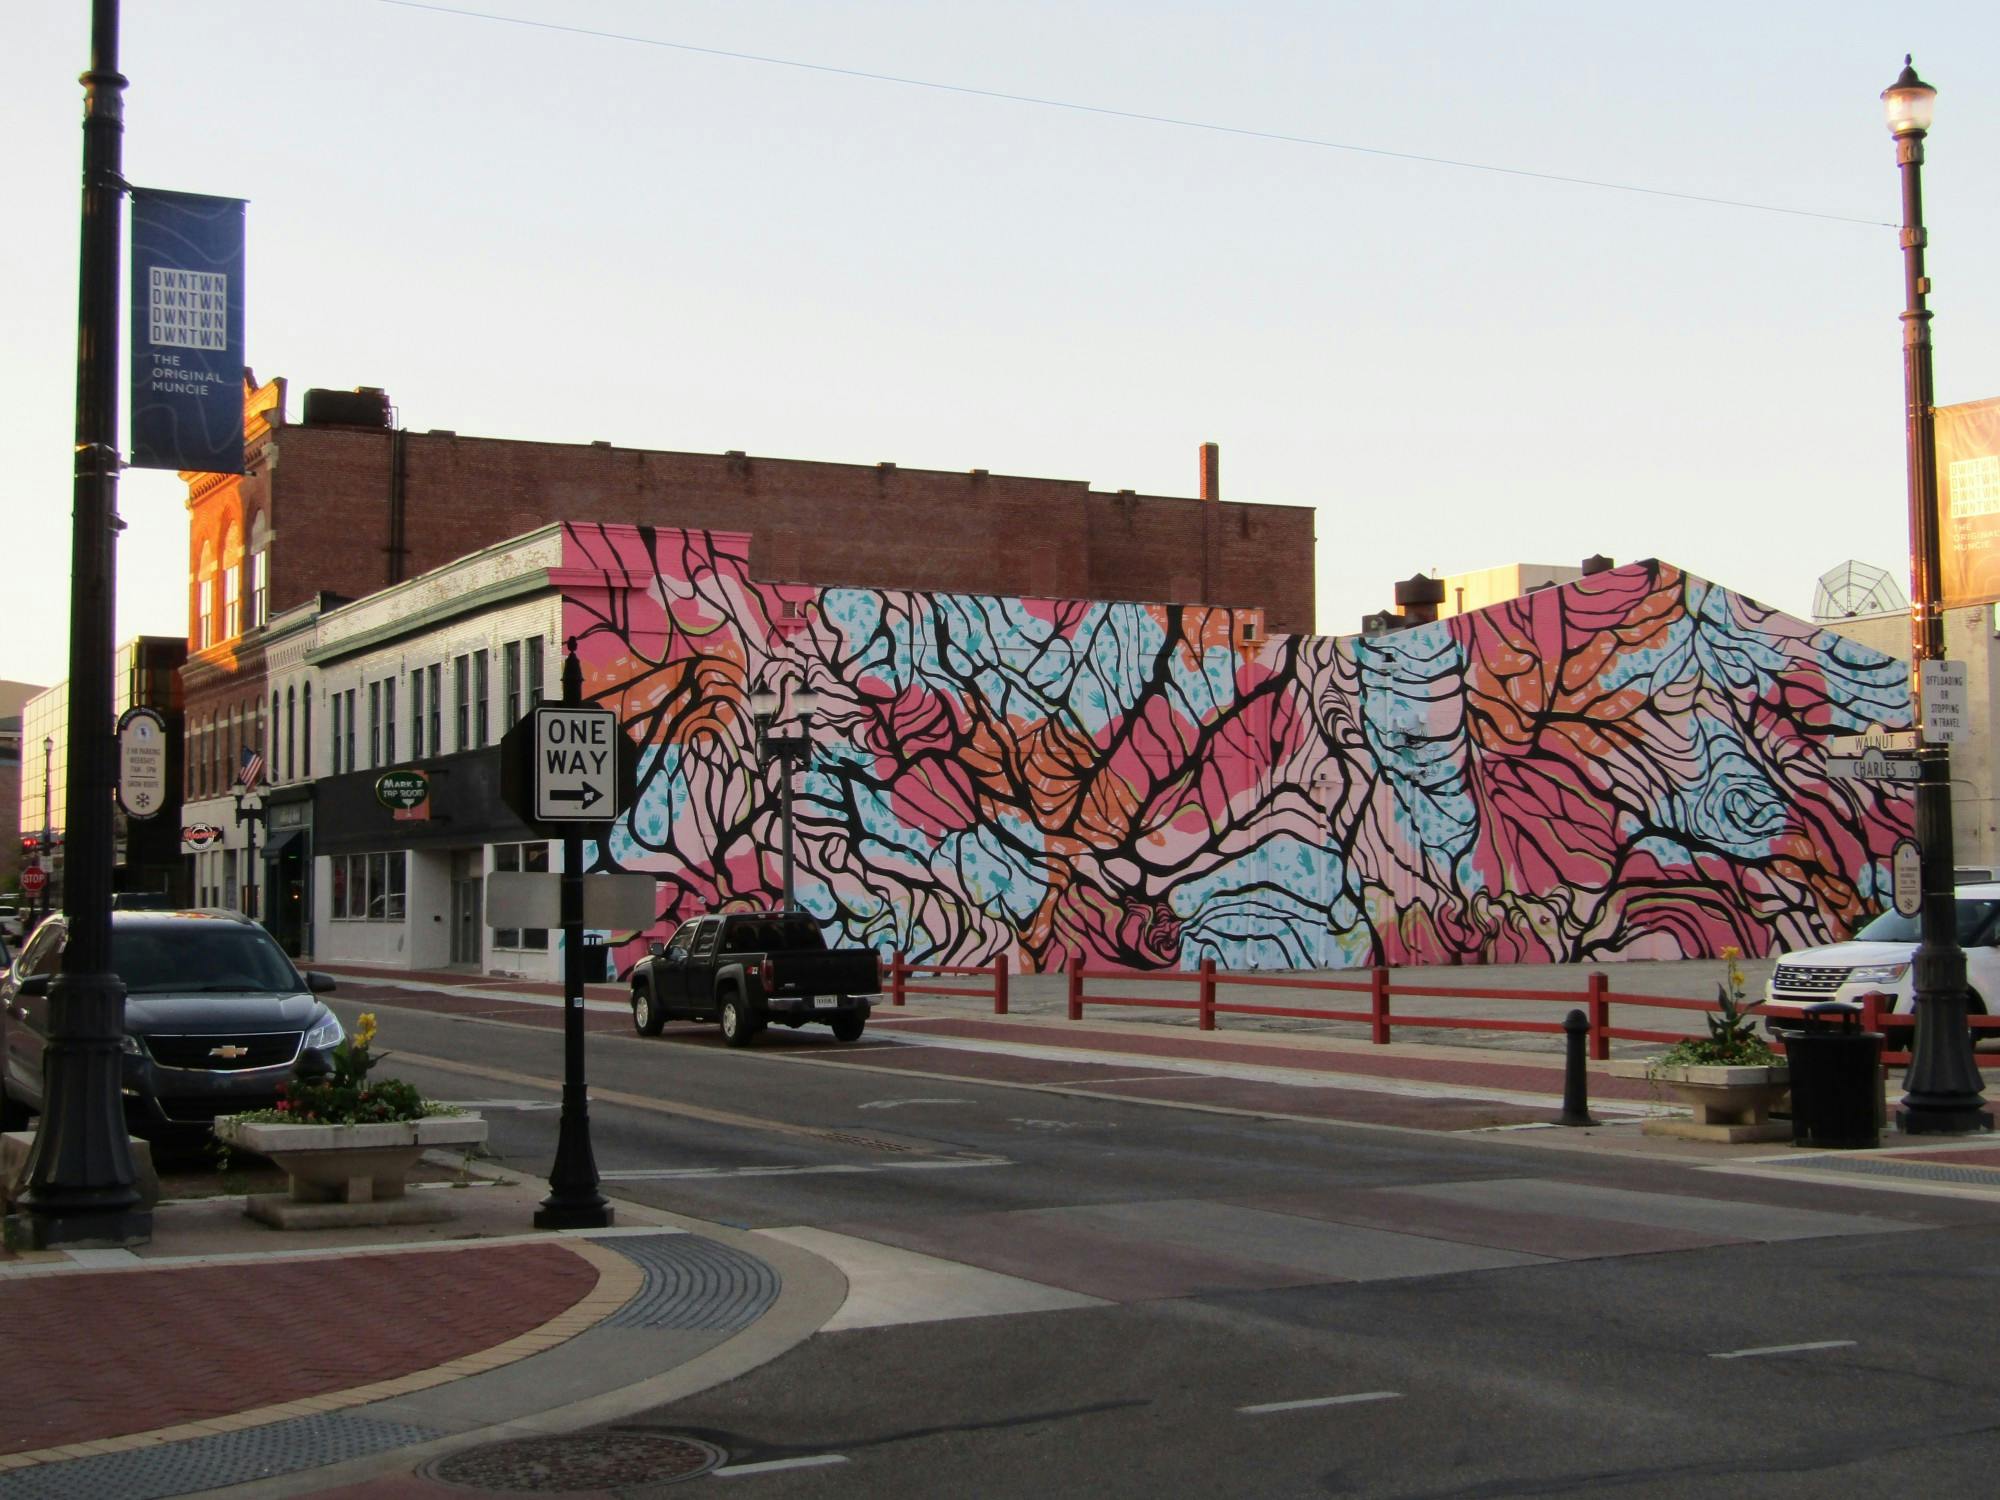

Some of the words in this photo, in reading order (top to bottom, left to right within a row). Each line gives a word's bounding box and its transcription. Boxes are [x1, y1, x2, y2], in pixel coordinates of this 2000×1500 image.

[152, 270, 224, 292] DWNTWN
[152, 288, 224, 311] DWNTWN
[152, 306, 224, 329] DWNTWN
[152, 325, 224, 347] DWNTWN
[152, 354, 181, 367] THE
[152, 367, 224, 384] ORIGINAL
[152, 381, 209, 396] MUNCIE
[1925, 675, 1963, 686] OFFLOADING
[1931, 703, 1960, 714] STOPPING
[1930, 718, 1938, 727] IN
[1938, 717, 1961, 728] TRAVEL
[548, 718, 607, 744] ONE
[1938, 731, 1954, 742] LANE
[1855, 734, 1895, 751] WALNUT
[1907, 735, 1920, 748] ST
[546, 749, 608, 775] WAY
[1853, 761, 1897, 777] CHARLES
[1909, 765, 1919, 777] ST
[383, 790, 398, 798] TAP
[400, 789, 425, 797] ROOM
[23, 873, 45, 884] STOP
